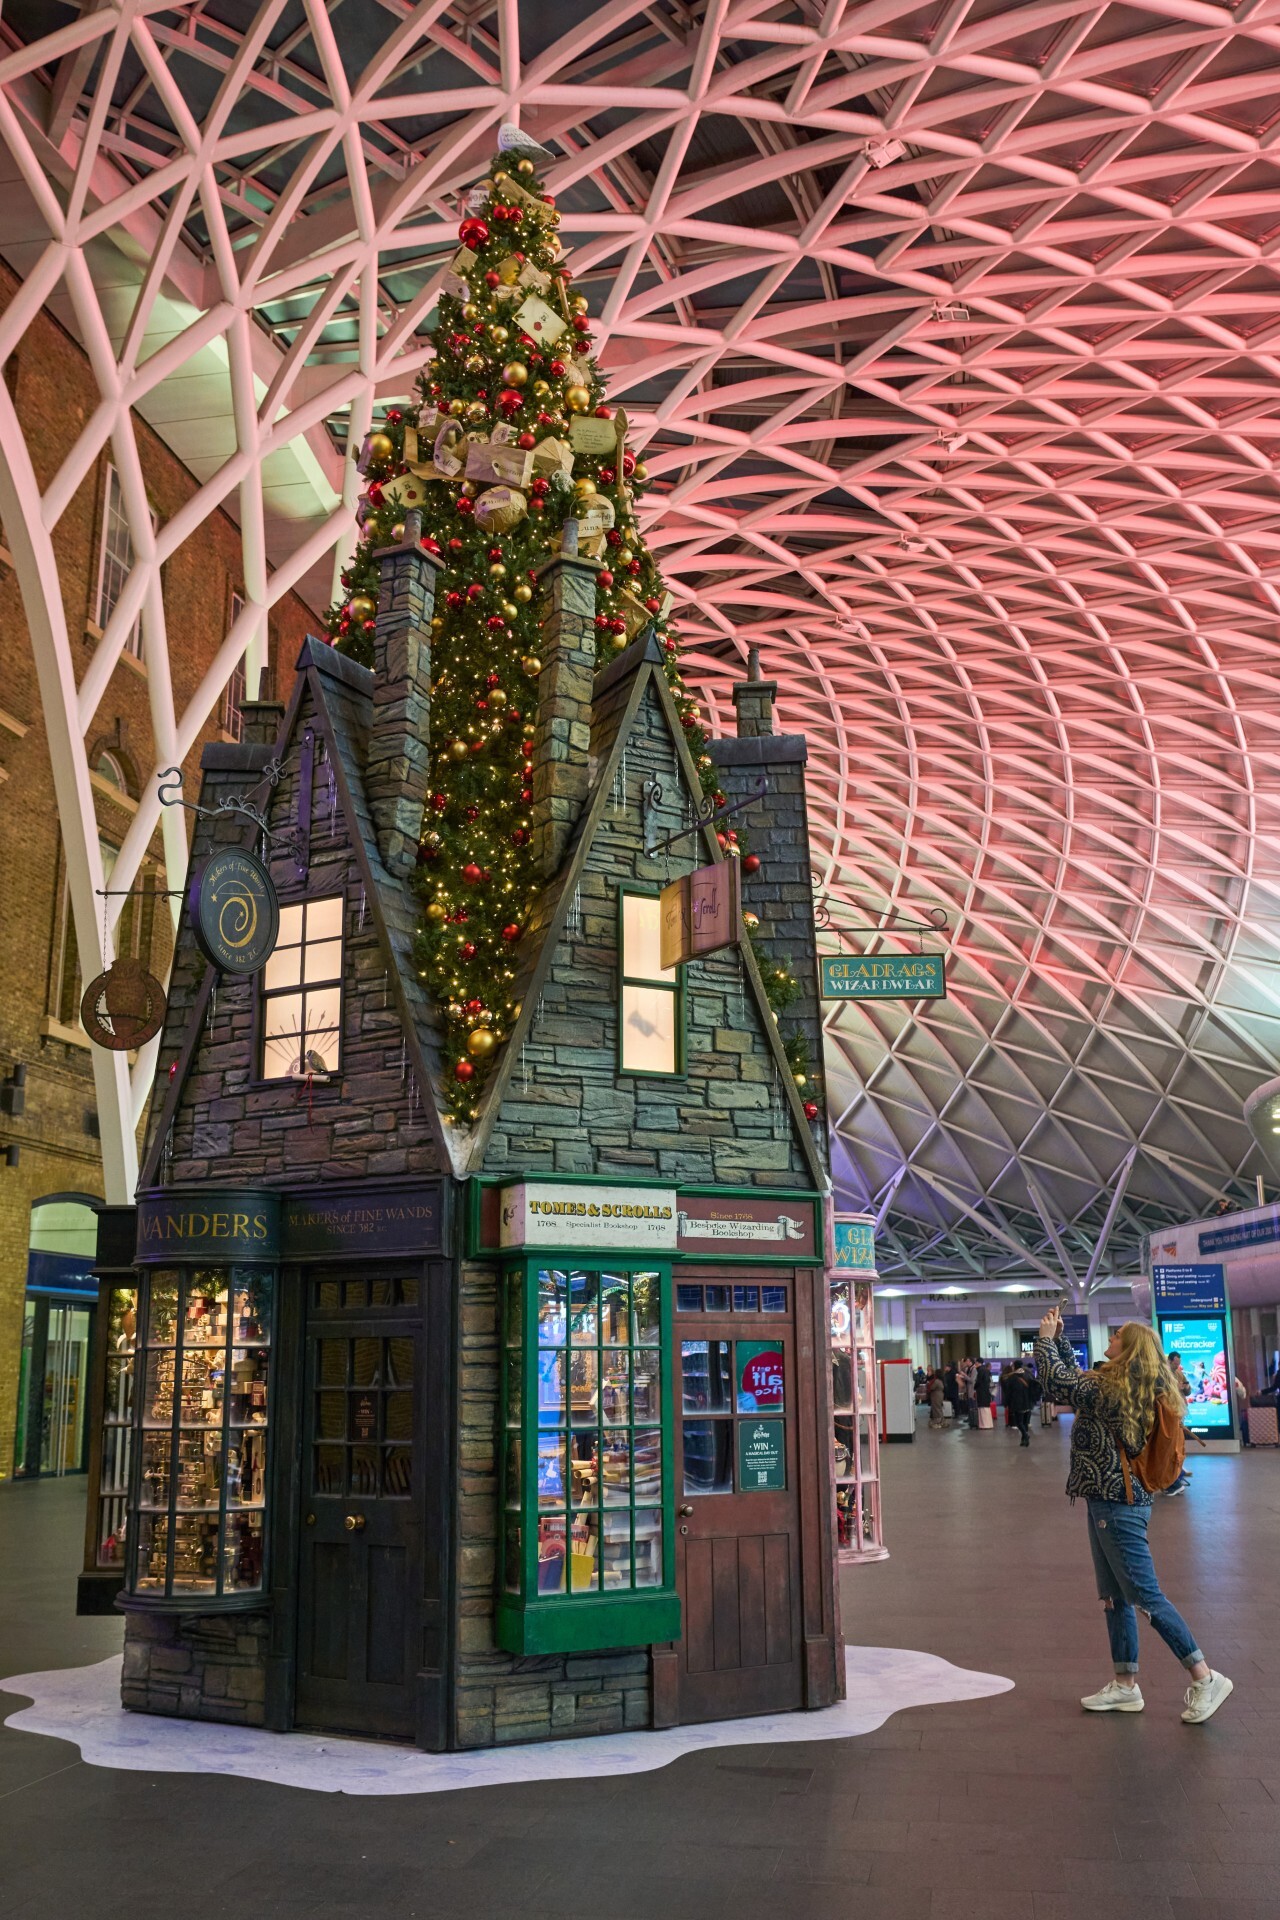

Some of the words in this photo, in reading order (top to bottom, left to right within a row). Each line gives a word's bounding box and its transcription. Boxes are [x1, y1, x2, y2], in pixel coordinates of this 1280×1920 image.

[829, 963, 936, 978] GLADRAGS
[830, 979, 937, 990] WIZARDWEAR
[289, 1211, 339, 1226] MAKERS
[340, 1210, 351, 1223] of
[354, 1209, 383, 1222] FINE
[386, 1206, 433, 1220] WANDS
[710, 1211, 733, 1219] Since
[327, 1224, 356, 1234] SINCE
[359, 1223, 374, 1233] 382
[565, 1220, 601, 1230] Specialist
[603, 1223, 638, 1231] Bookshop
[690, 1221, 727, 1232] Bespoke
[729, 1222, 775, 1233] Wizarding
[712, 1229, 754, 1238] Bookshop
[1170, 1341, 1216, 1349] Nutcracker
[753, 1442, 769, 1450] WIN
